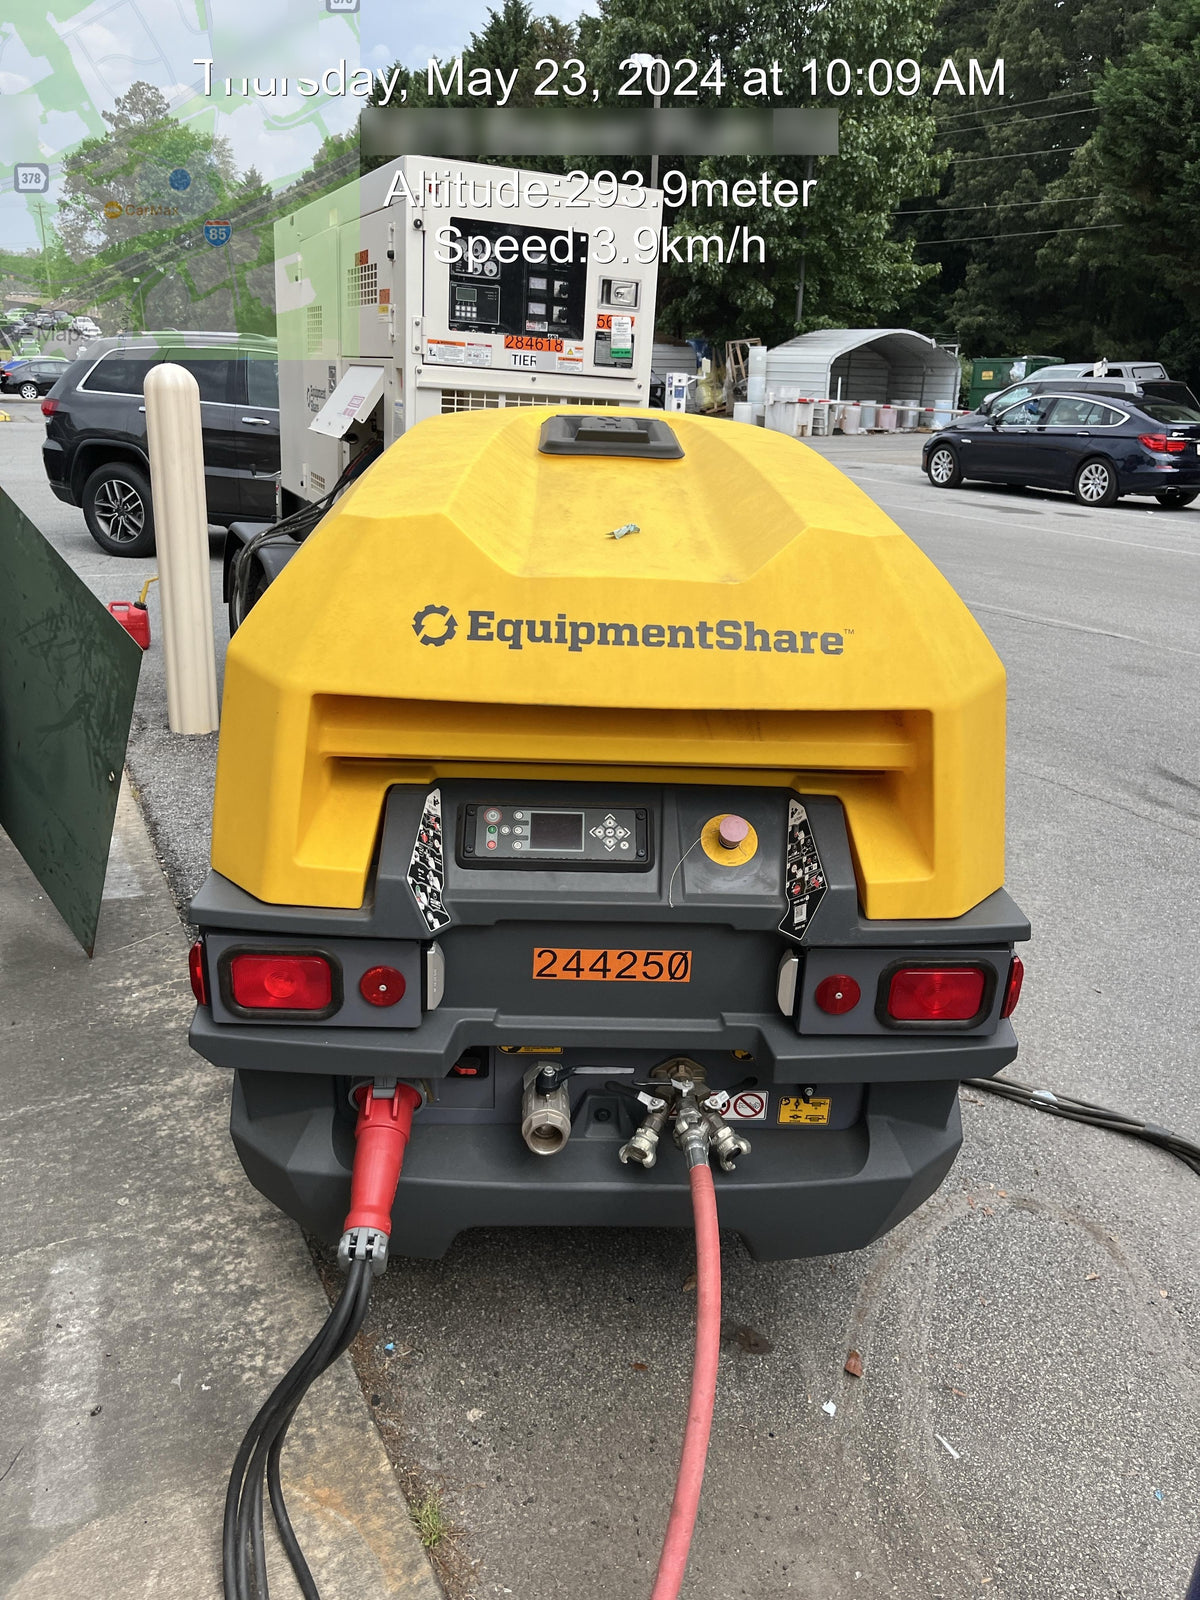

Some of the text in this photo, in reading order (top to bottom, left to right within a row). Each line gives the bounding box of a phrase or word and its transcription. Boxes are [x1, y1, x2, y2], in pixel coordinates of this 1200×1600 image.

[505, 335, 563, 353] 284618
[466, 610, 844, 656] EquipmentShare
[536, 949, 689, 981] 244250
